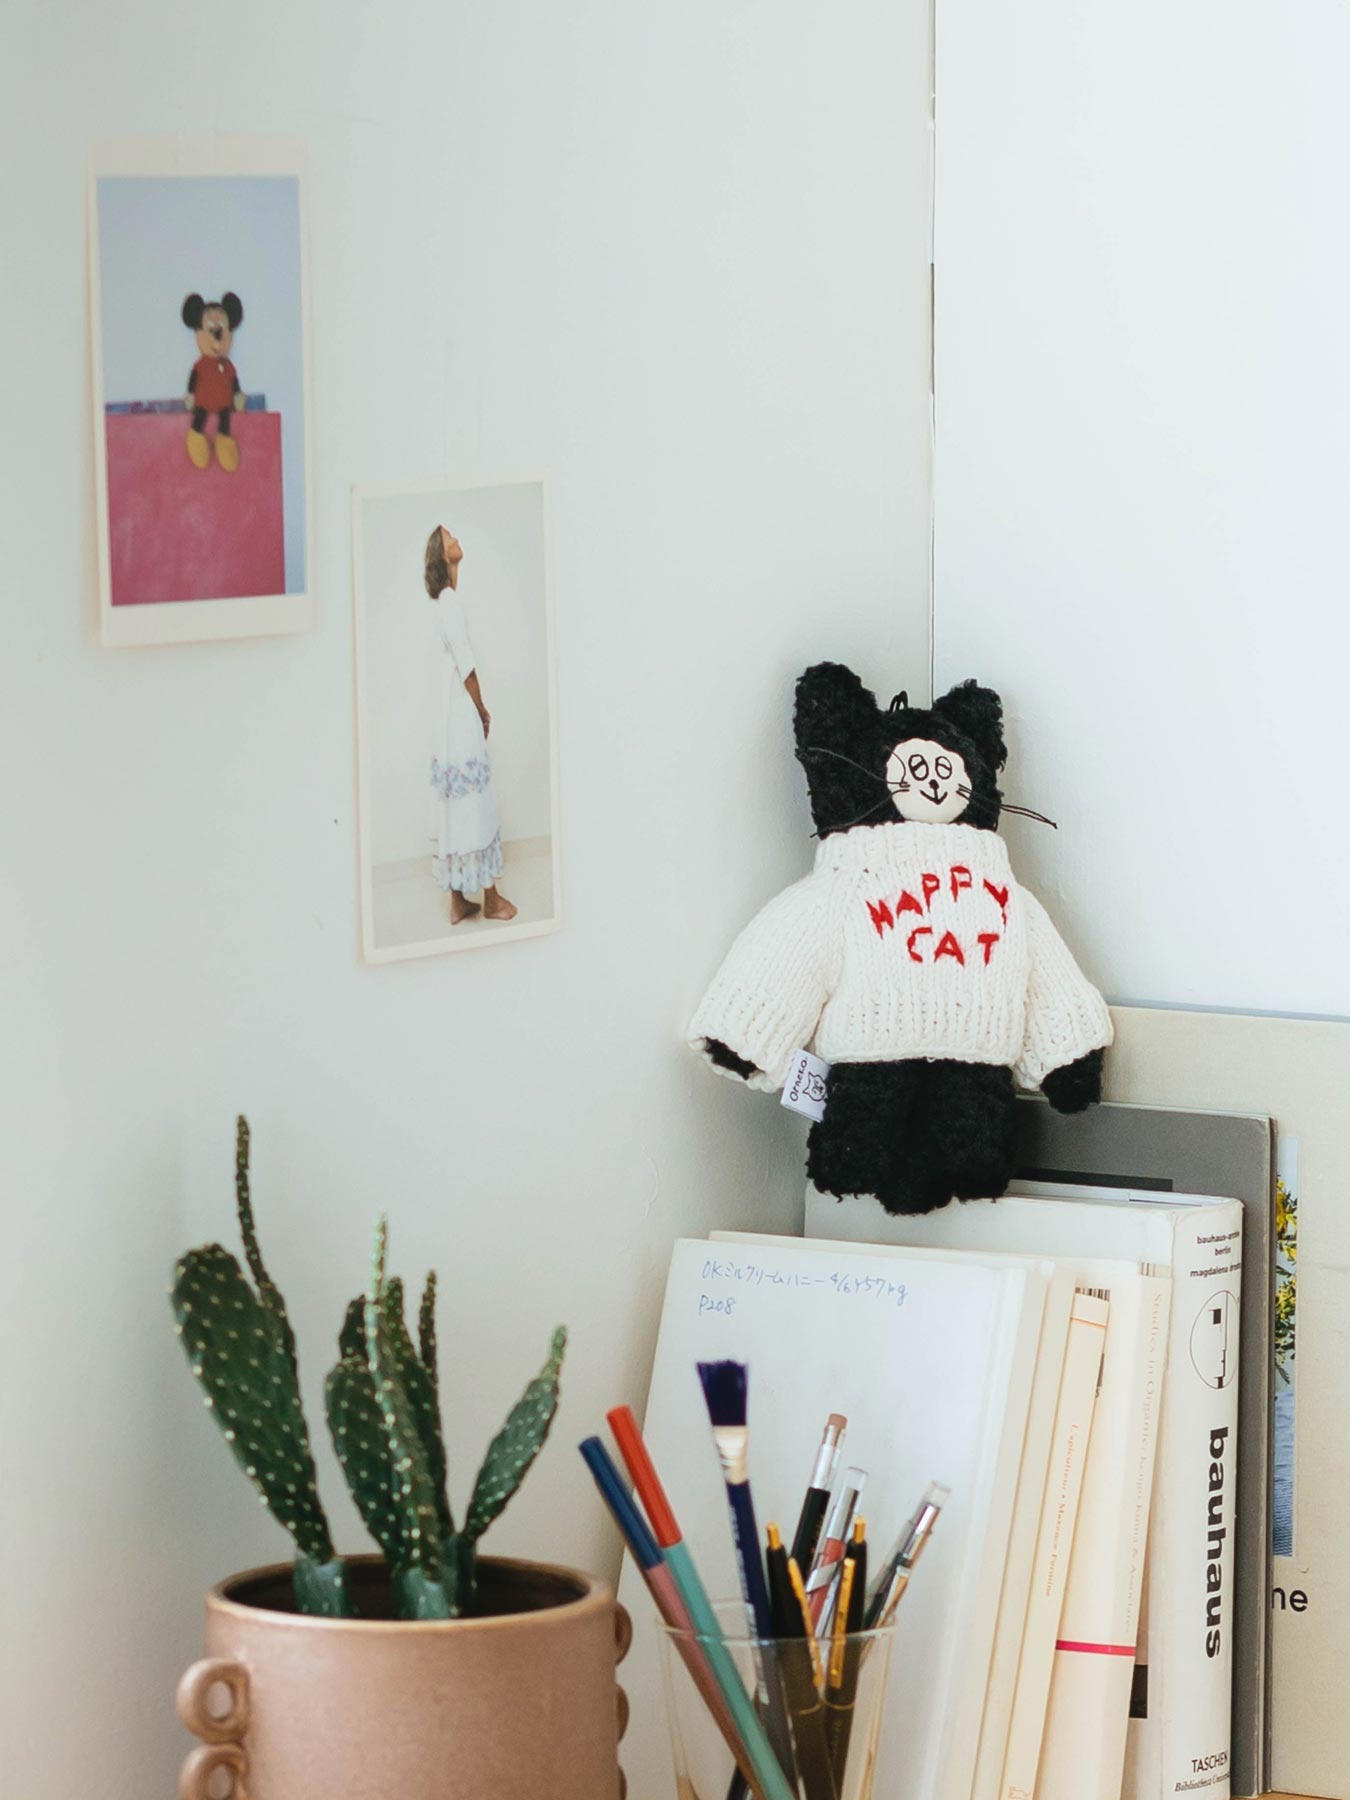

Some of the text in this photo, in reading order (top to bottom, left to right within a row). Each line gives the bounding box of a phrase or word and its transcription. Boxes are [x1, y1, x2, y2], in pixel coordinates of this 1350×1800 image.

[866, 865, 1008, 940] HAPPY
[907, 927, 1000, 967] CAT
[1215, 1245, 1231, 1256] berlin
[1190, 1266, 1229, 1278] magdalena
[698, 1293, 736, 1316] P208
[1149, 1288, 1161, 1352] Studies
[1206, 1426, 1229, 1659] bauhaus
